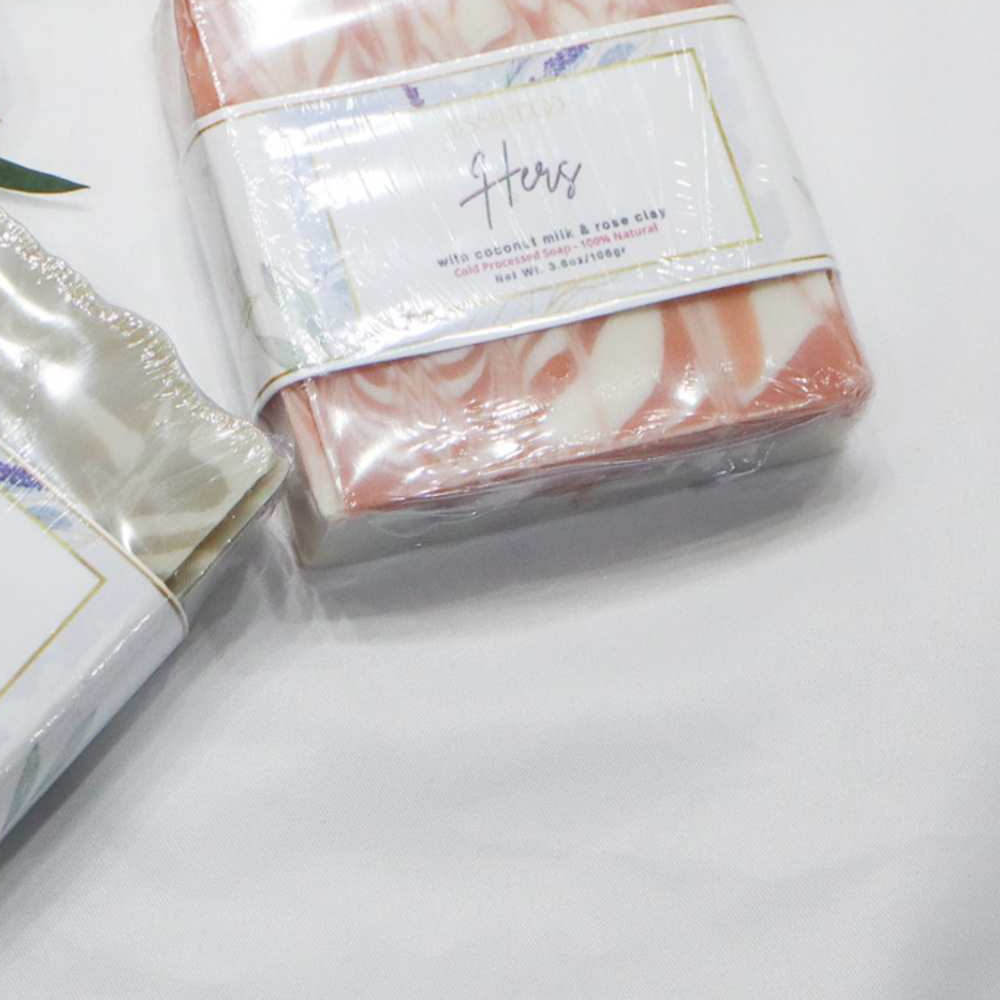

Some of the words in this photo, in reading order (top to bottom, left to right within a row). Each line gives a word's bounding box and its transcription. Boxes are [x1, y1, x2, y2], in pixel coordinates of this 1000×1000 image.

[459, 140, 582, 229] Hers
[454, 263, 481, 278] Cold
[483, 250, 540, 272] Processed
[543, 244, 572, 261] Soap
[581, 235, 611, 250] 100%
[614, 223, 659, 243] Natural
[543, 228, 573, 244] milk
[580, 224, 590, 235] &
[595, 217, 629, 231] rose
[635, 207, 667, 223] clay
